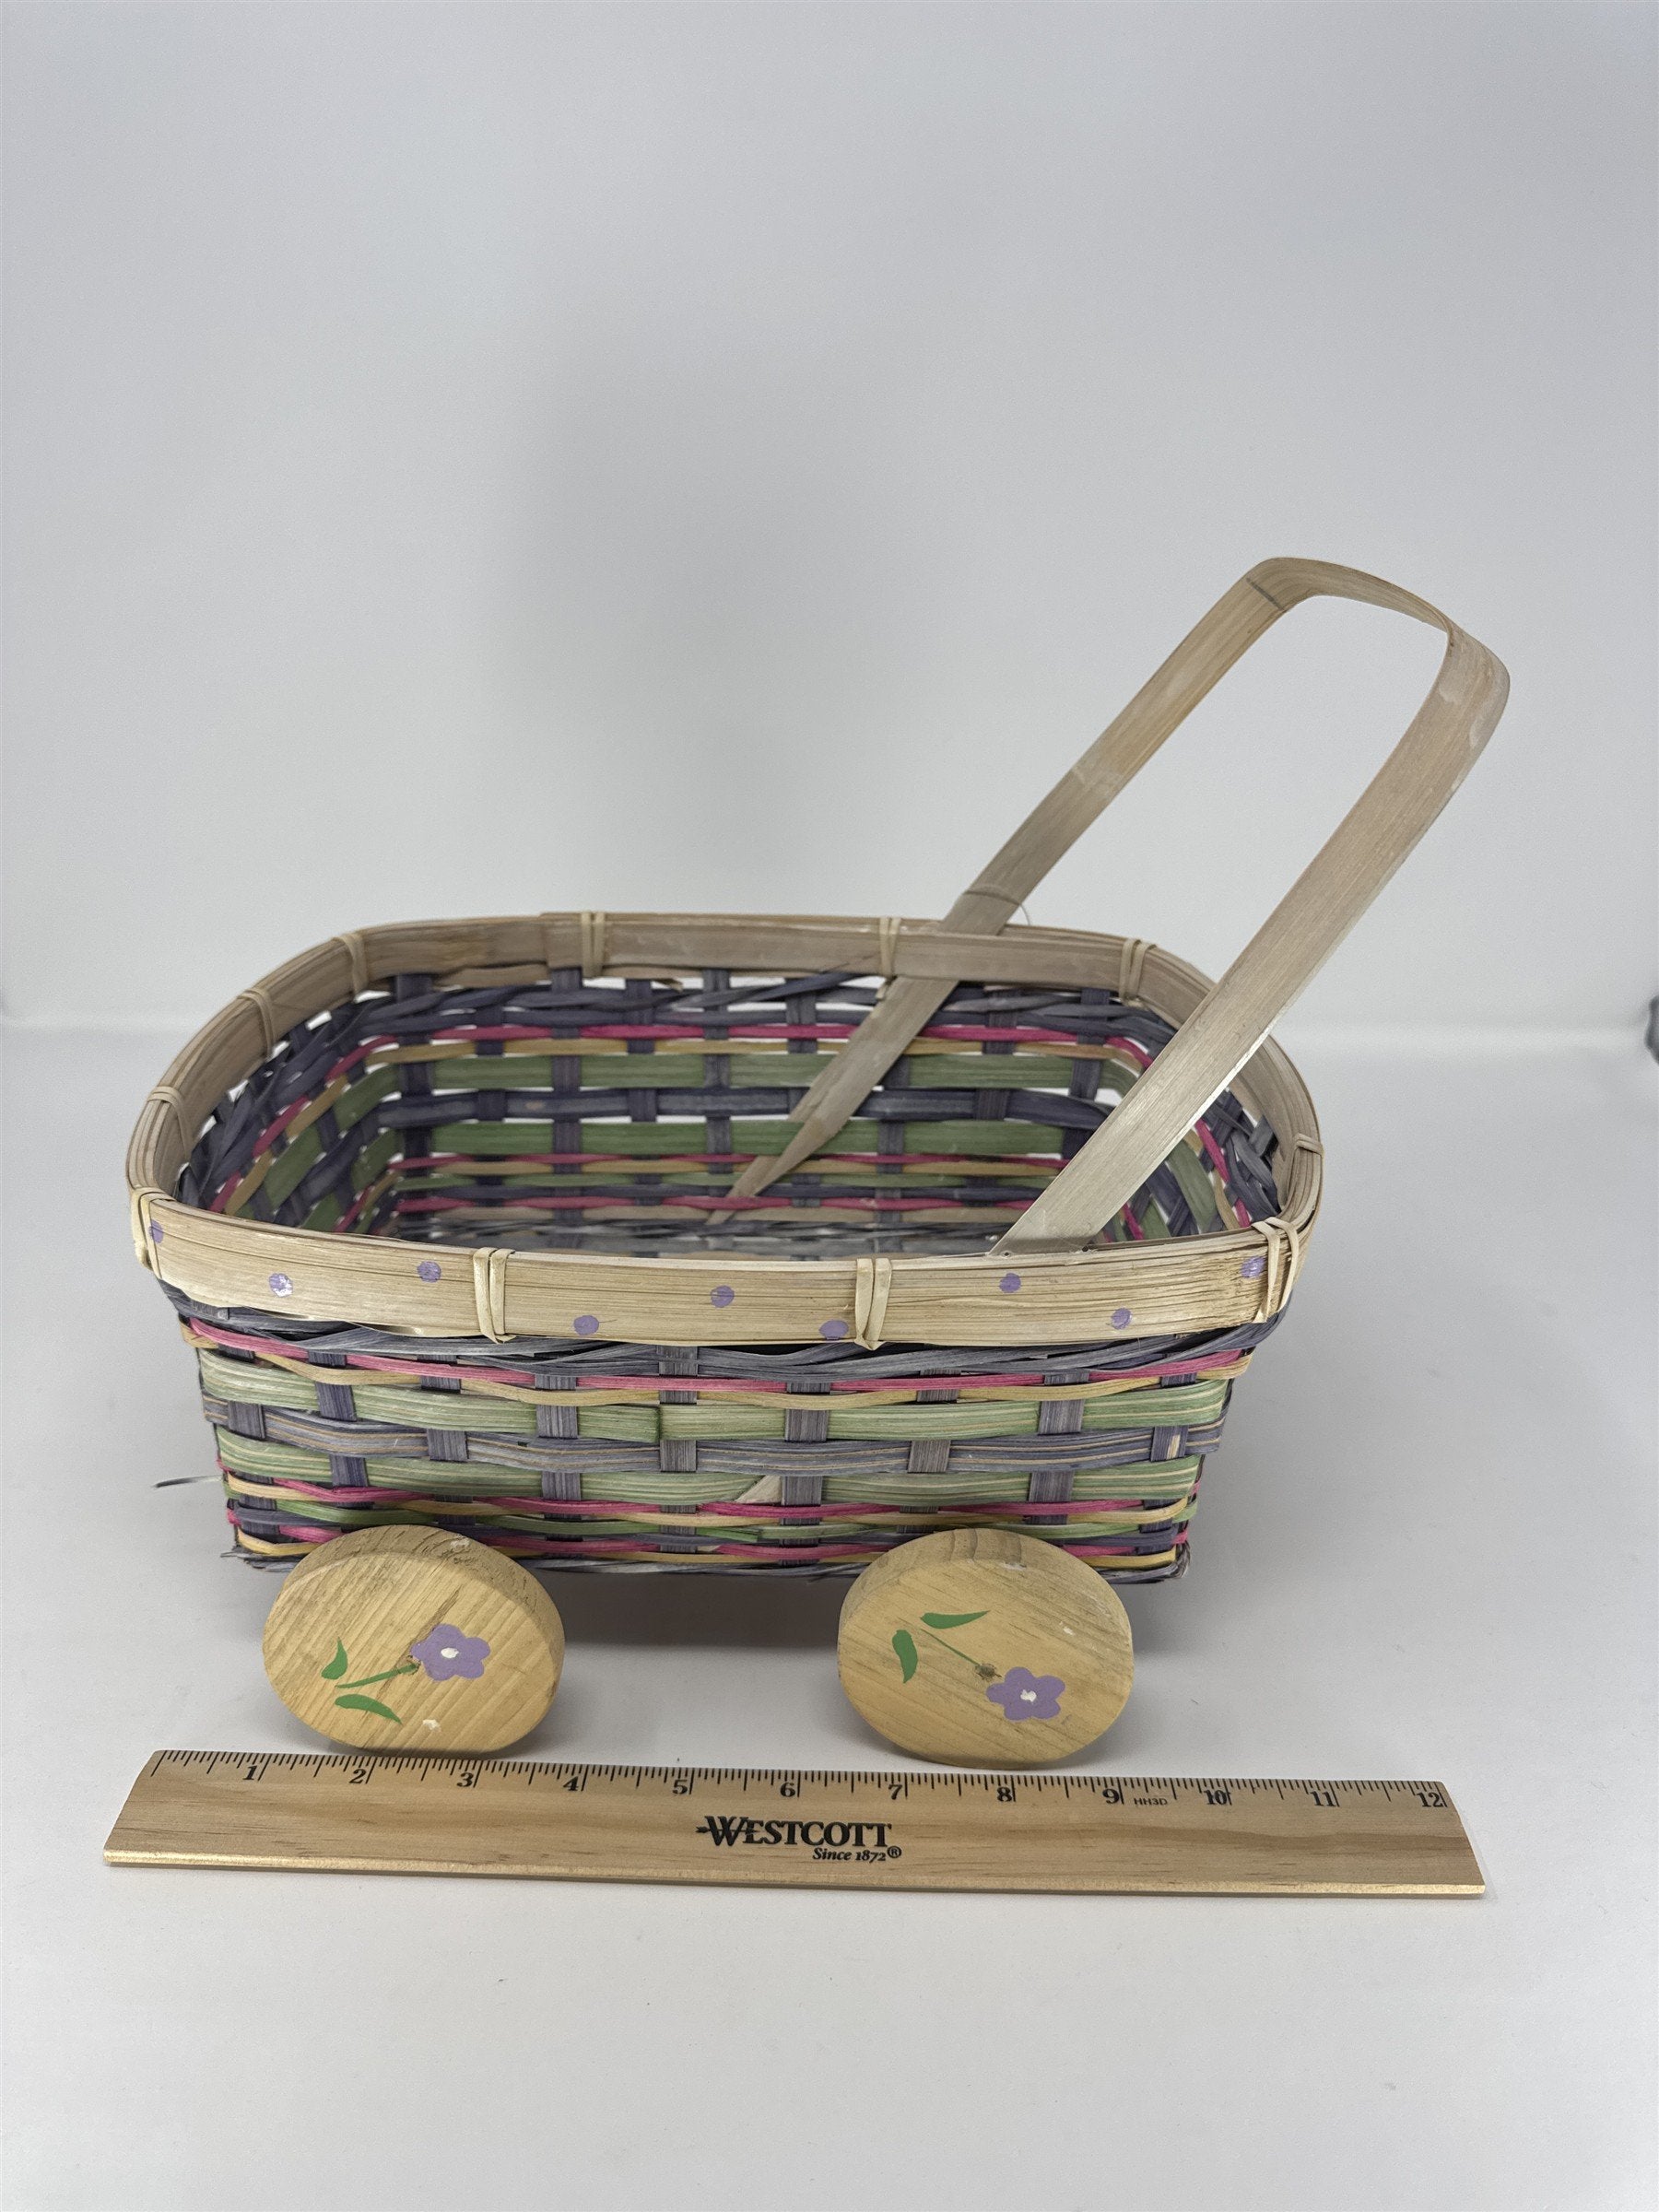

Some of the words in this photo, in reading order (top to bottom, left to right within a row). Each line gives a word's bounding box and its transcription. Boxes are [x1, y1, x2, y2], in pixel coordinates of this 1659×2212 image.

[242, 1765, 257, 1781] 1
[348, 1768, 367, 1784] 2
[456, 1771, 474, 1788] 3
[562, 1775, 579, 1792] 4
[672, 1779, 688, 1795] 5
[780, 1782, 795, 1798] 6
[888, 1783, 903, 1800] 7
[996, 1786, 1013, 1803] 8
[1101, 1788, 1121, 1805] 9
[1204, 1789, 1229, 1806] 10
[1310, 1790, 1336, 1807] 11
[1416, 1792, 1444, 1808] 12
[702, 1815, 892, 1848] WESTCOTT
[812, 1846, 853, 1862] Since
